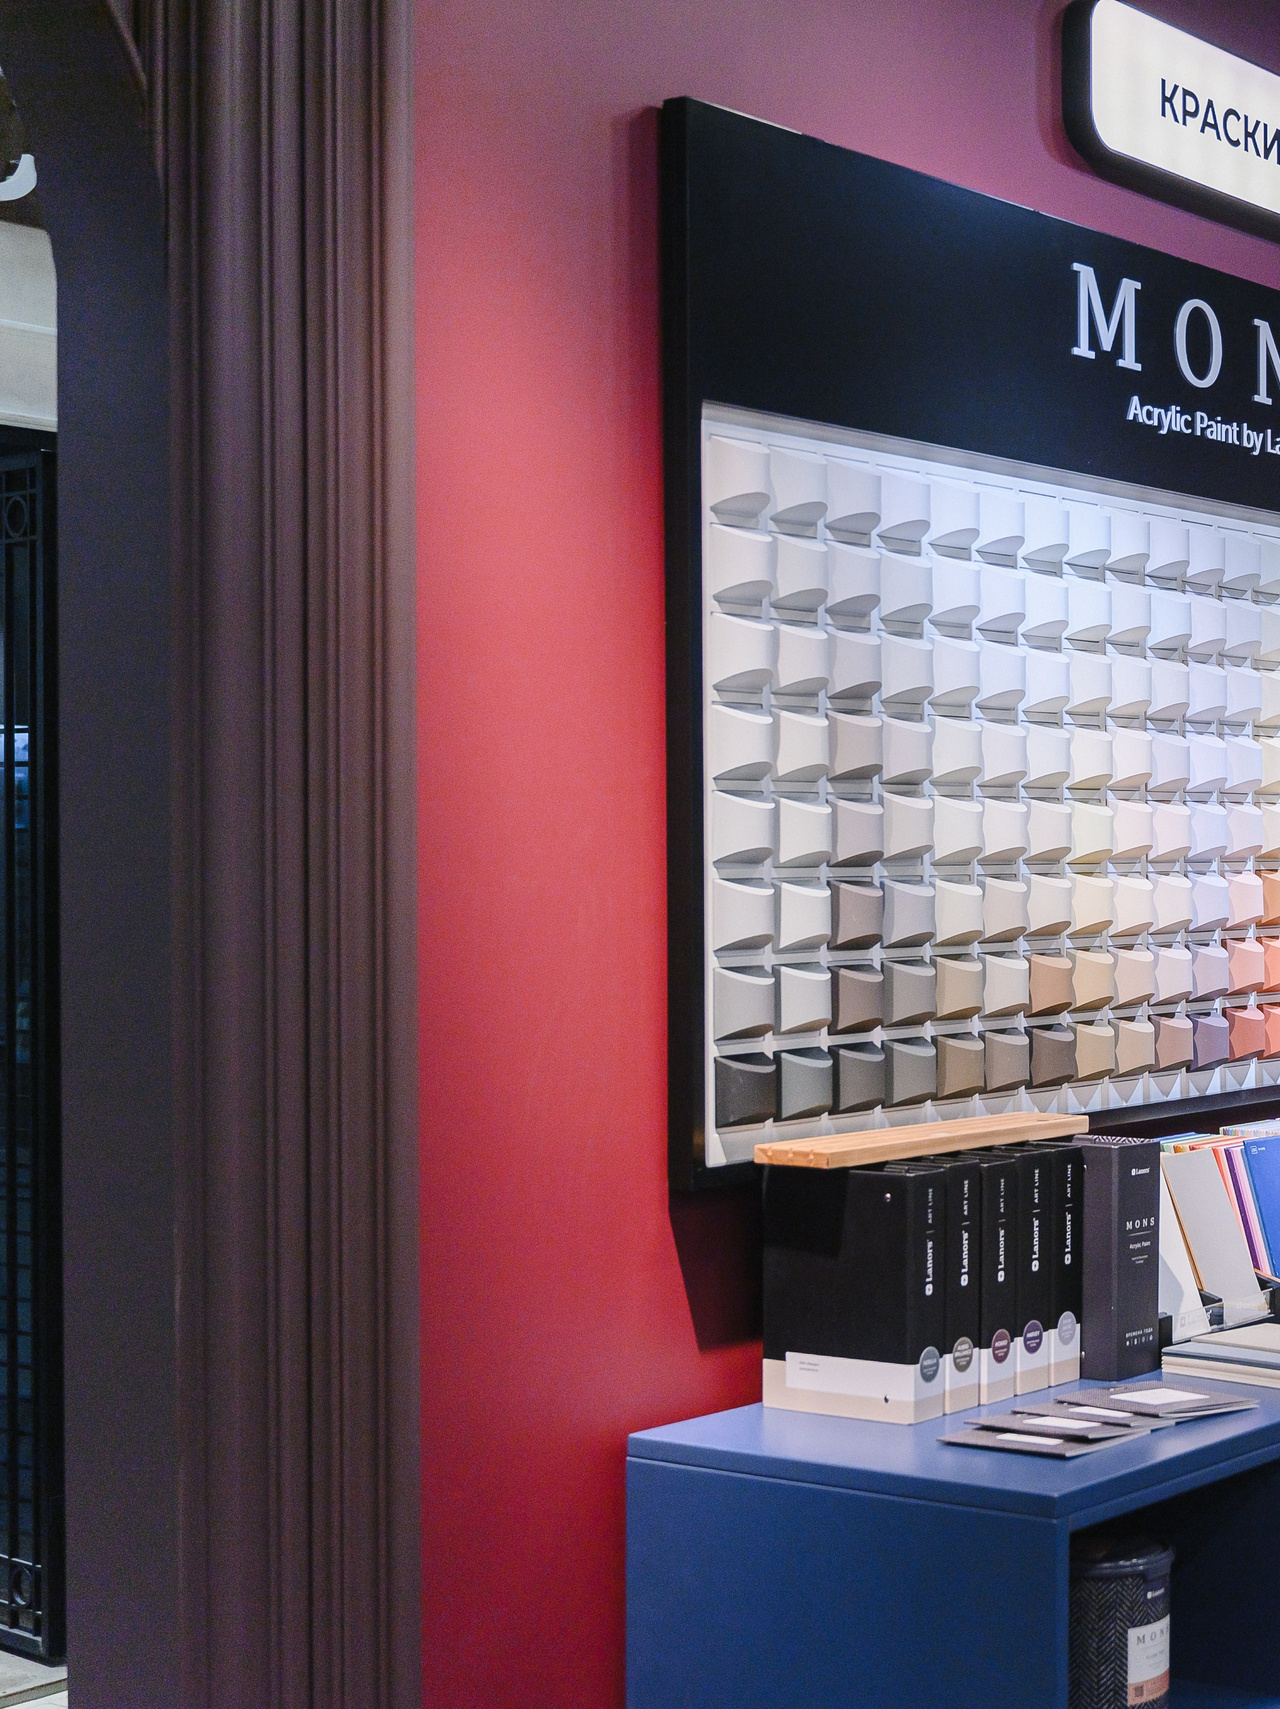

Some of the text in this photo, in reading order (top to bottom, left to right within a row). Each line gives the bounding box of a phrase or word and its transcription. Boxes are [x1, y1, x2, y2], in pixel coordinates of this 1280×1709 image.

[1126, 395, 1192, 435] Acrylic
[1194, 412, 1240, 447] Paint
[1241, 424, 1264, 456] by
[1126, 1216, 1155, 1231] MONS
